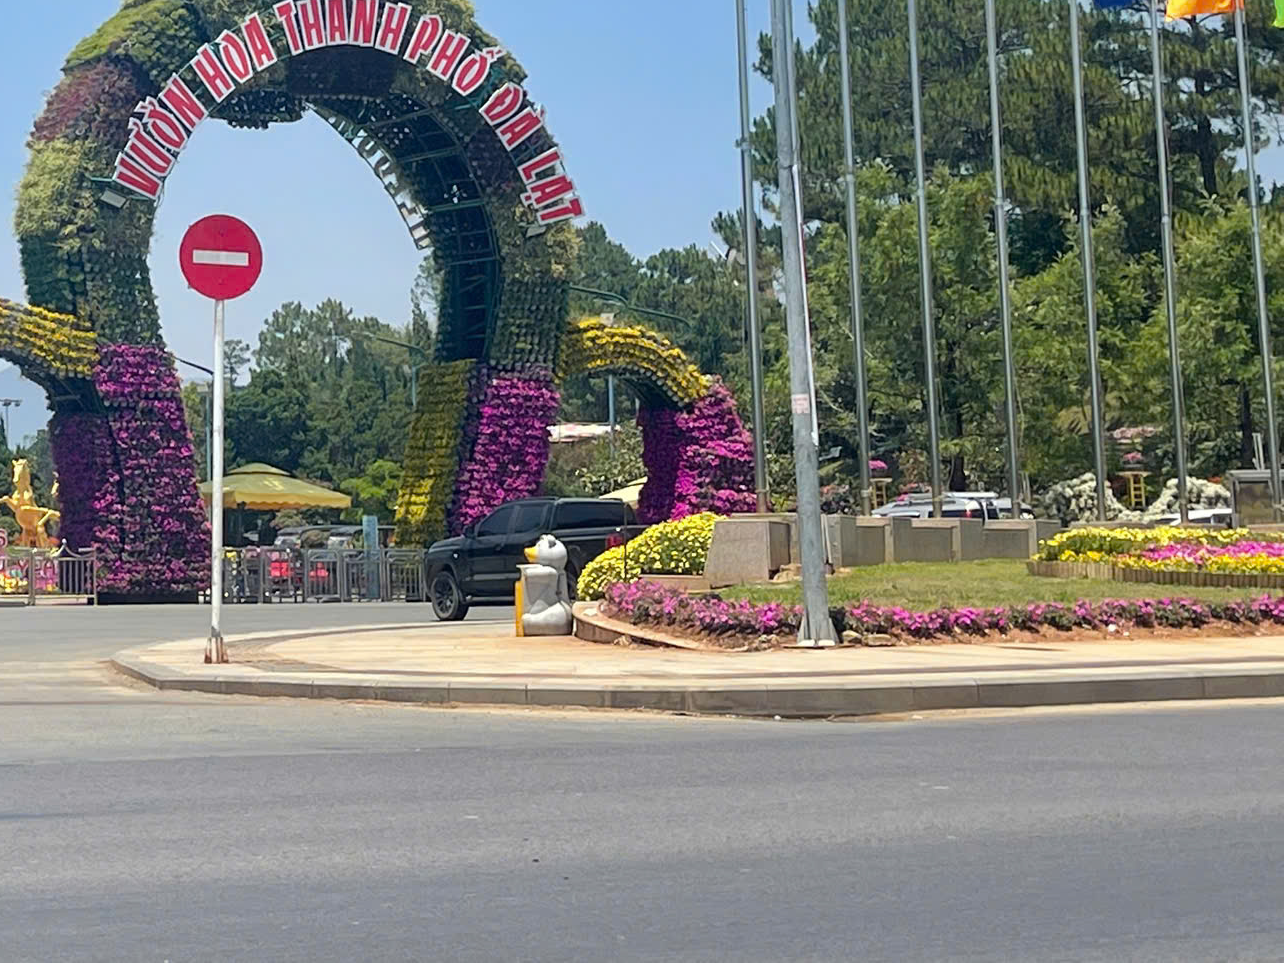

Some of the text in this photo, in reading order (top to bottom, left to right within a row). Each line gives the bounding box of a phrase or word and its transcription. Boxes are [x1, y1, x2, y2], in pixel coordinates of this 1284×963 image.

[113, 73, 208, 199] VƯỜN
[191, 12, 277, 103] HOA
[403, 15, 505, 96] PHỐ
[479, 82, 547, 151] ĐÀ
[517, 147, 584, 224] LẠT
